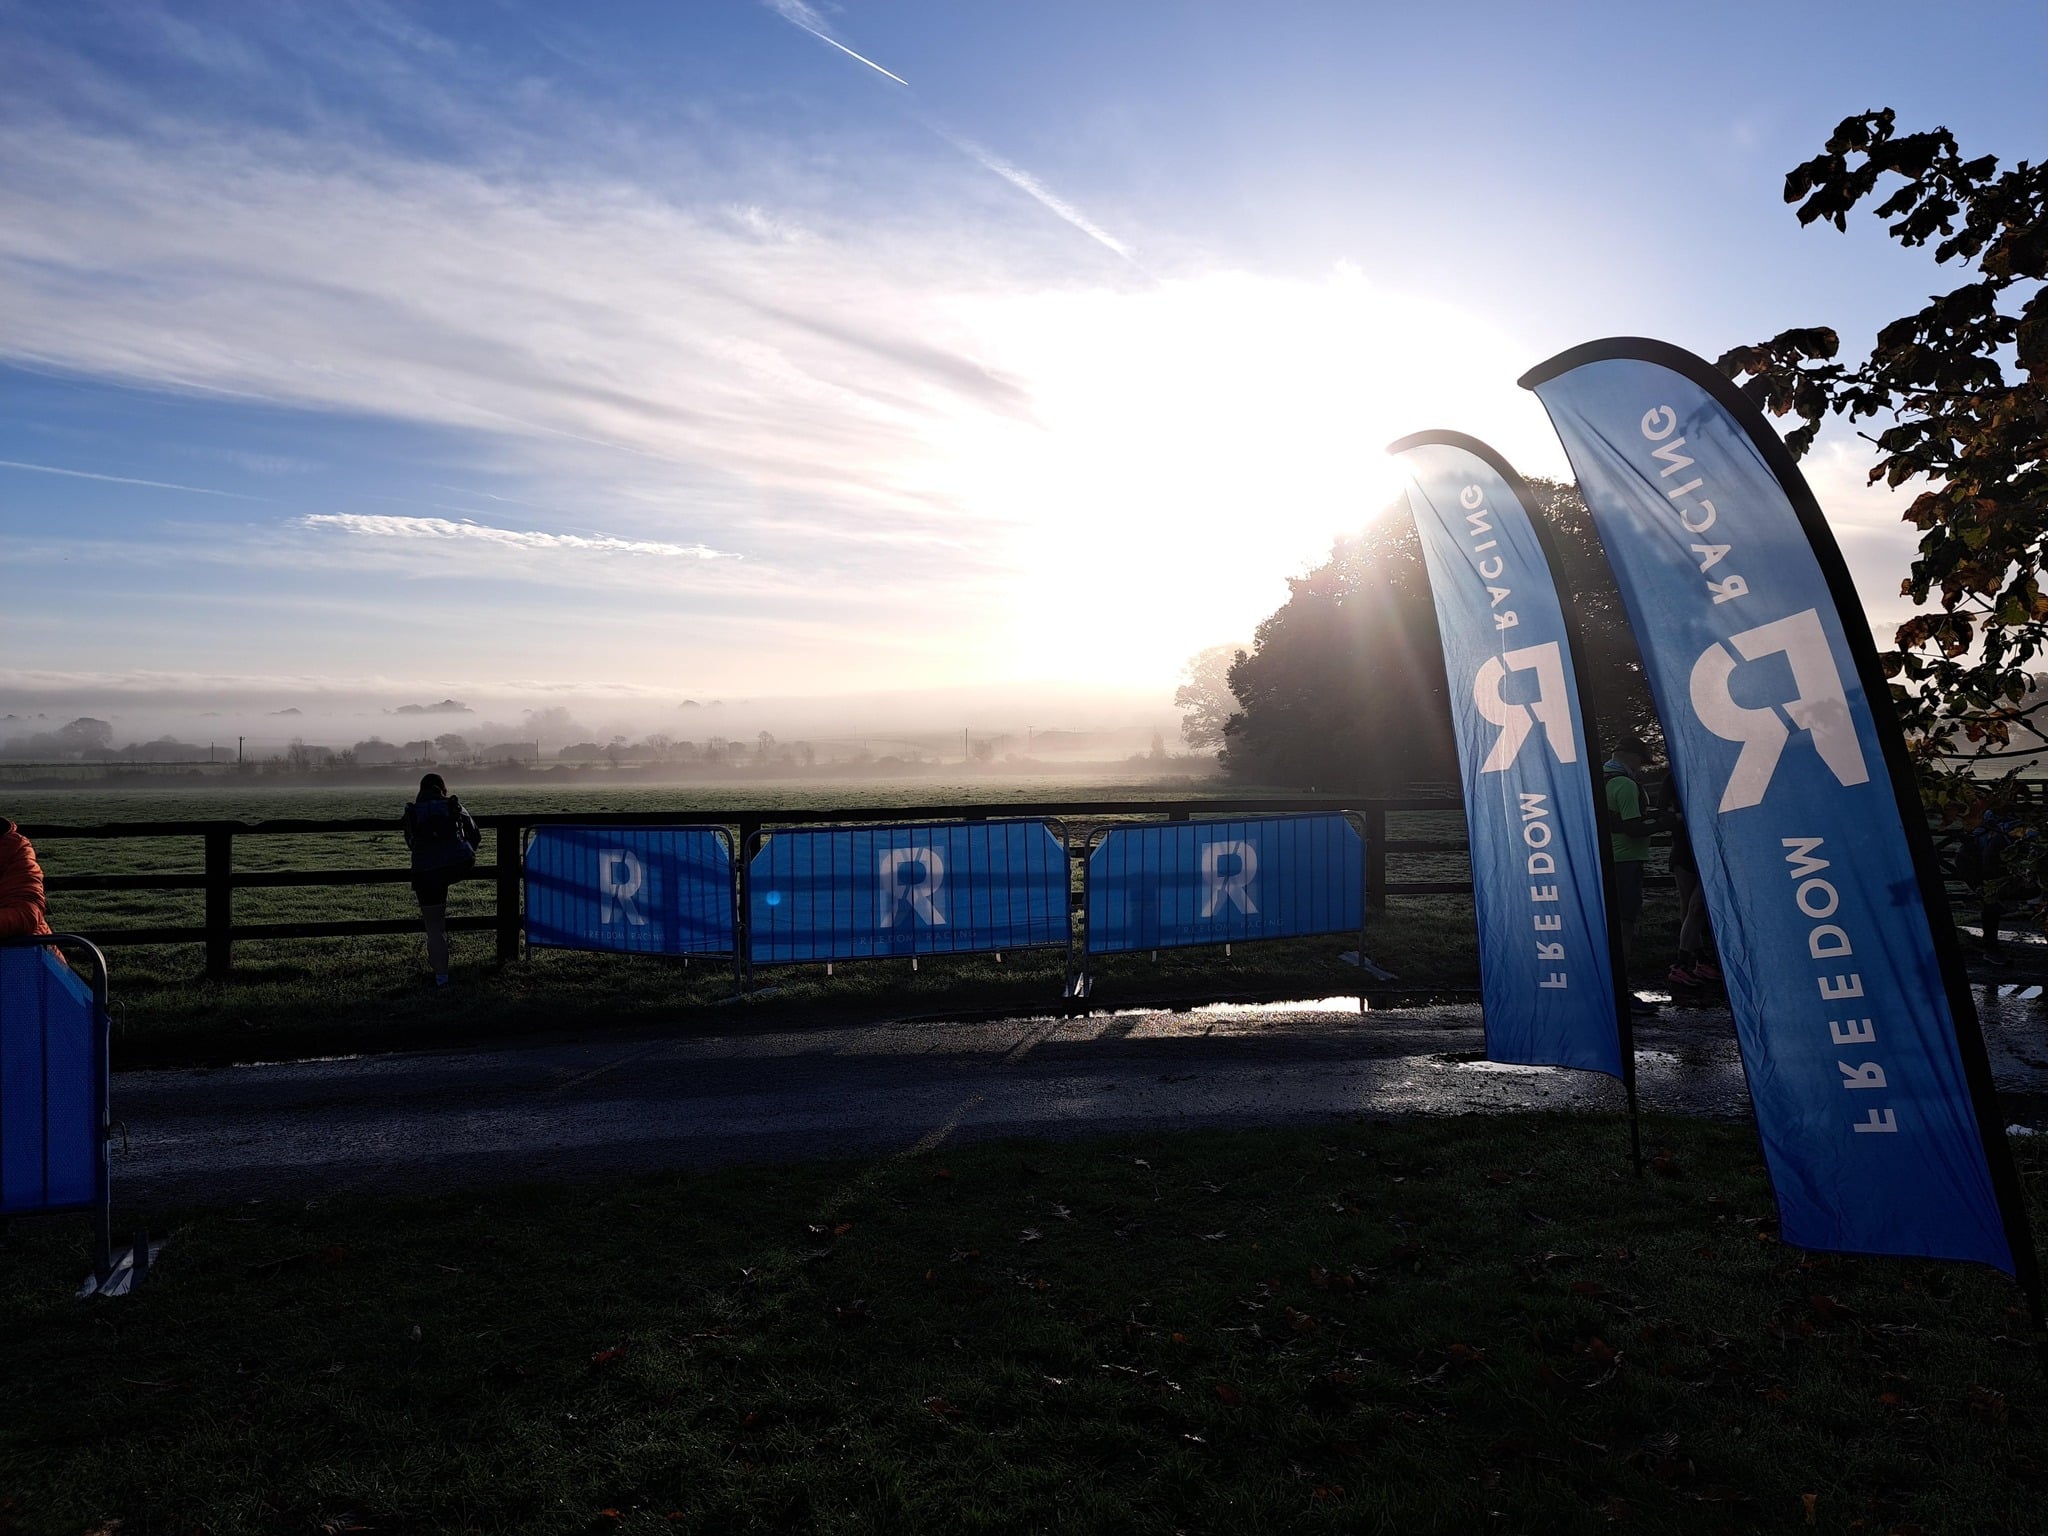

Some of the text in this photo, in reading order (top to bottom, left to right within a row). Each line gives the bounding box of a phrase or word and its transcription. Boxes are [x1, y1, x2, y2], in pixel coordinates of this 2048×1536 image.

[600, 848, 646, 926] R
[879, 846, 946, 928] R
[1201, 839, 1259, 918] R
